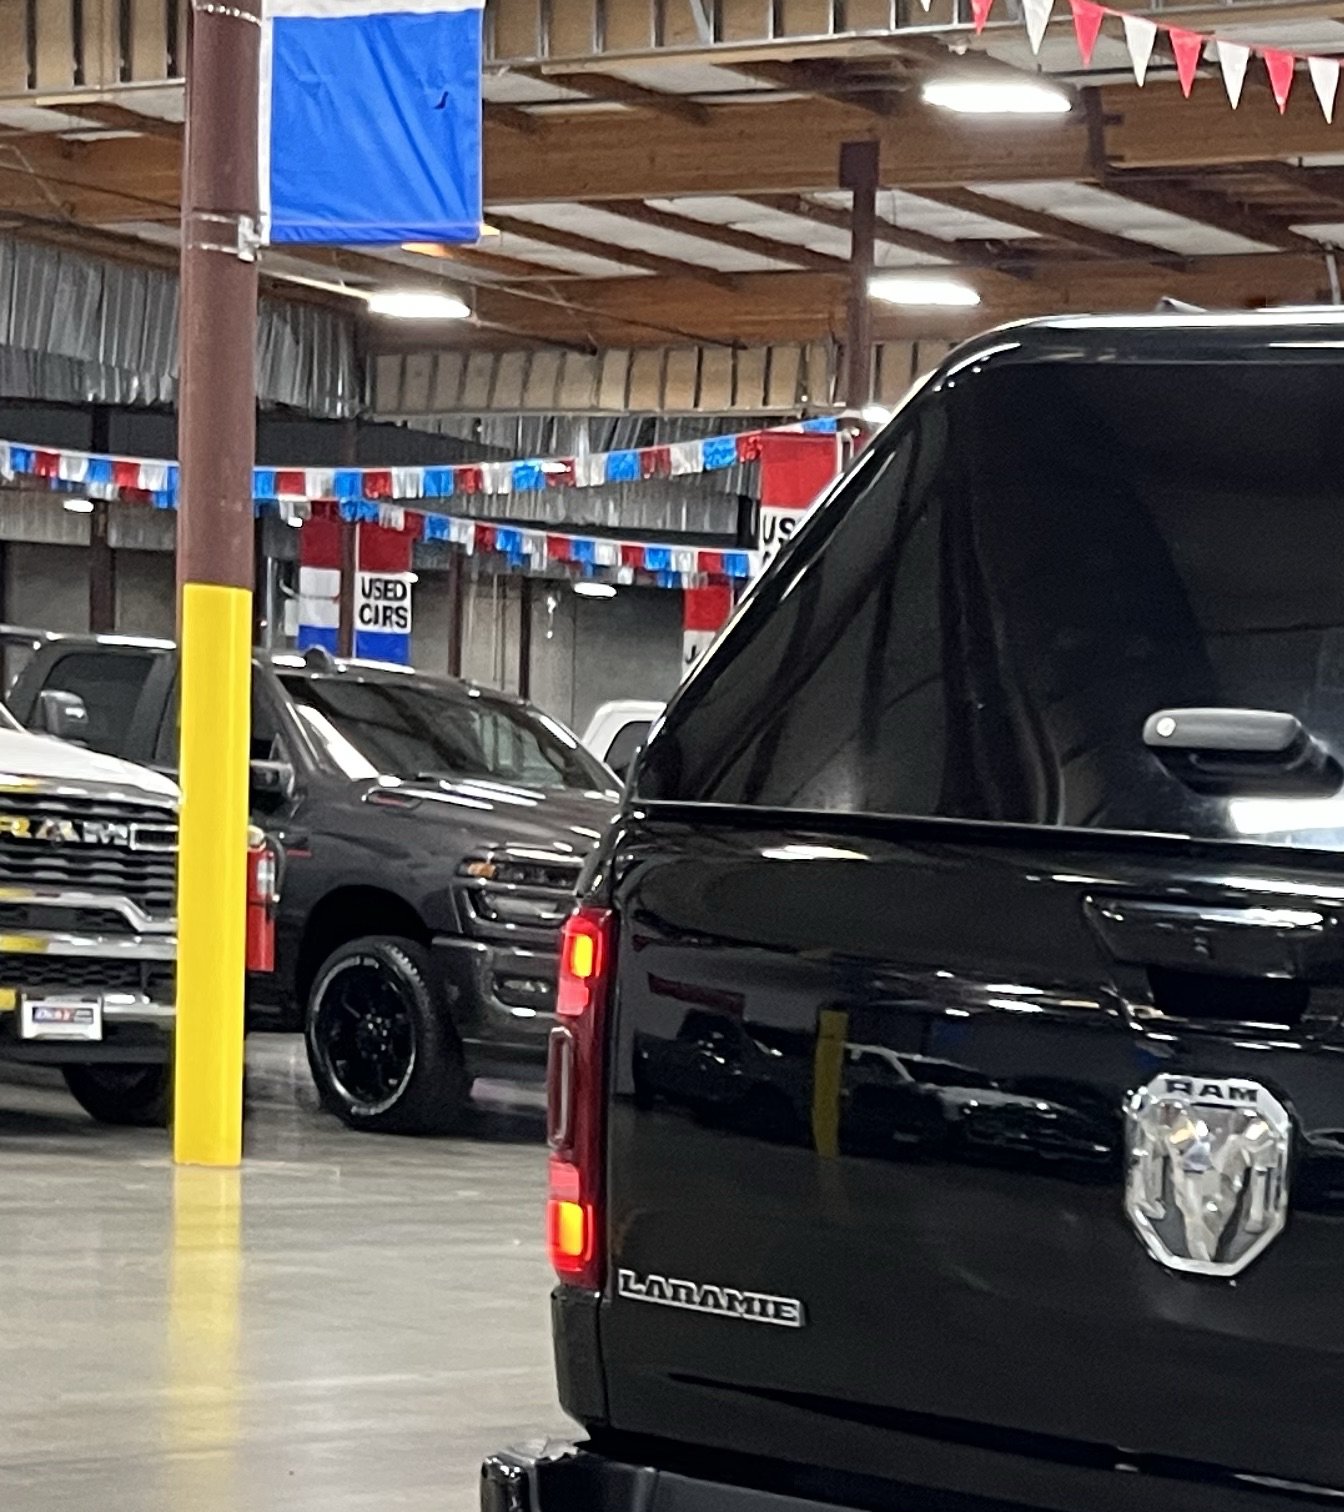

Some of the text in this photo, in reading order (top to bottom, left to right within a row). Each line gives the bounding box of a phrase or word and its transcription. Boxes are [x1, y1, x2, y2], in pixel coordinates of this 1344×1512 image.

[361, 576, 408, 601] USED
[0, 815, 128, 846] RAM
[1166, 1078, 1258, 1102] RAM
[618, 1268, 805, 1328] LARAMIE
